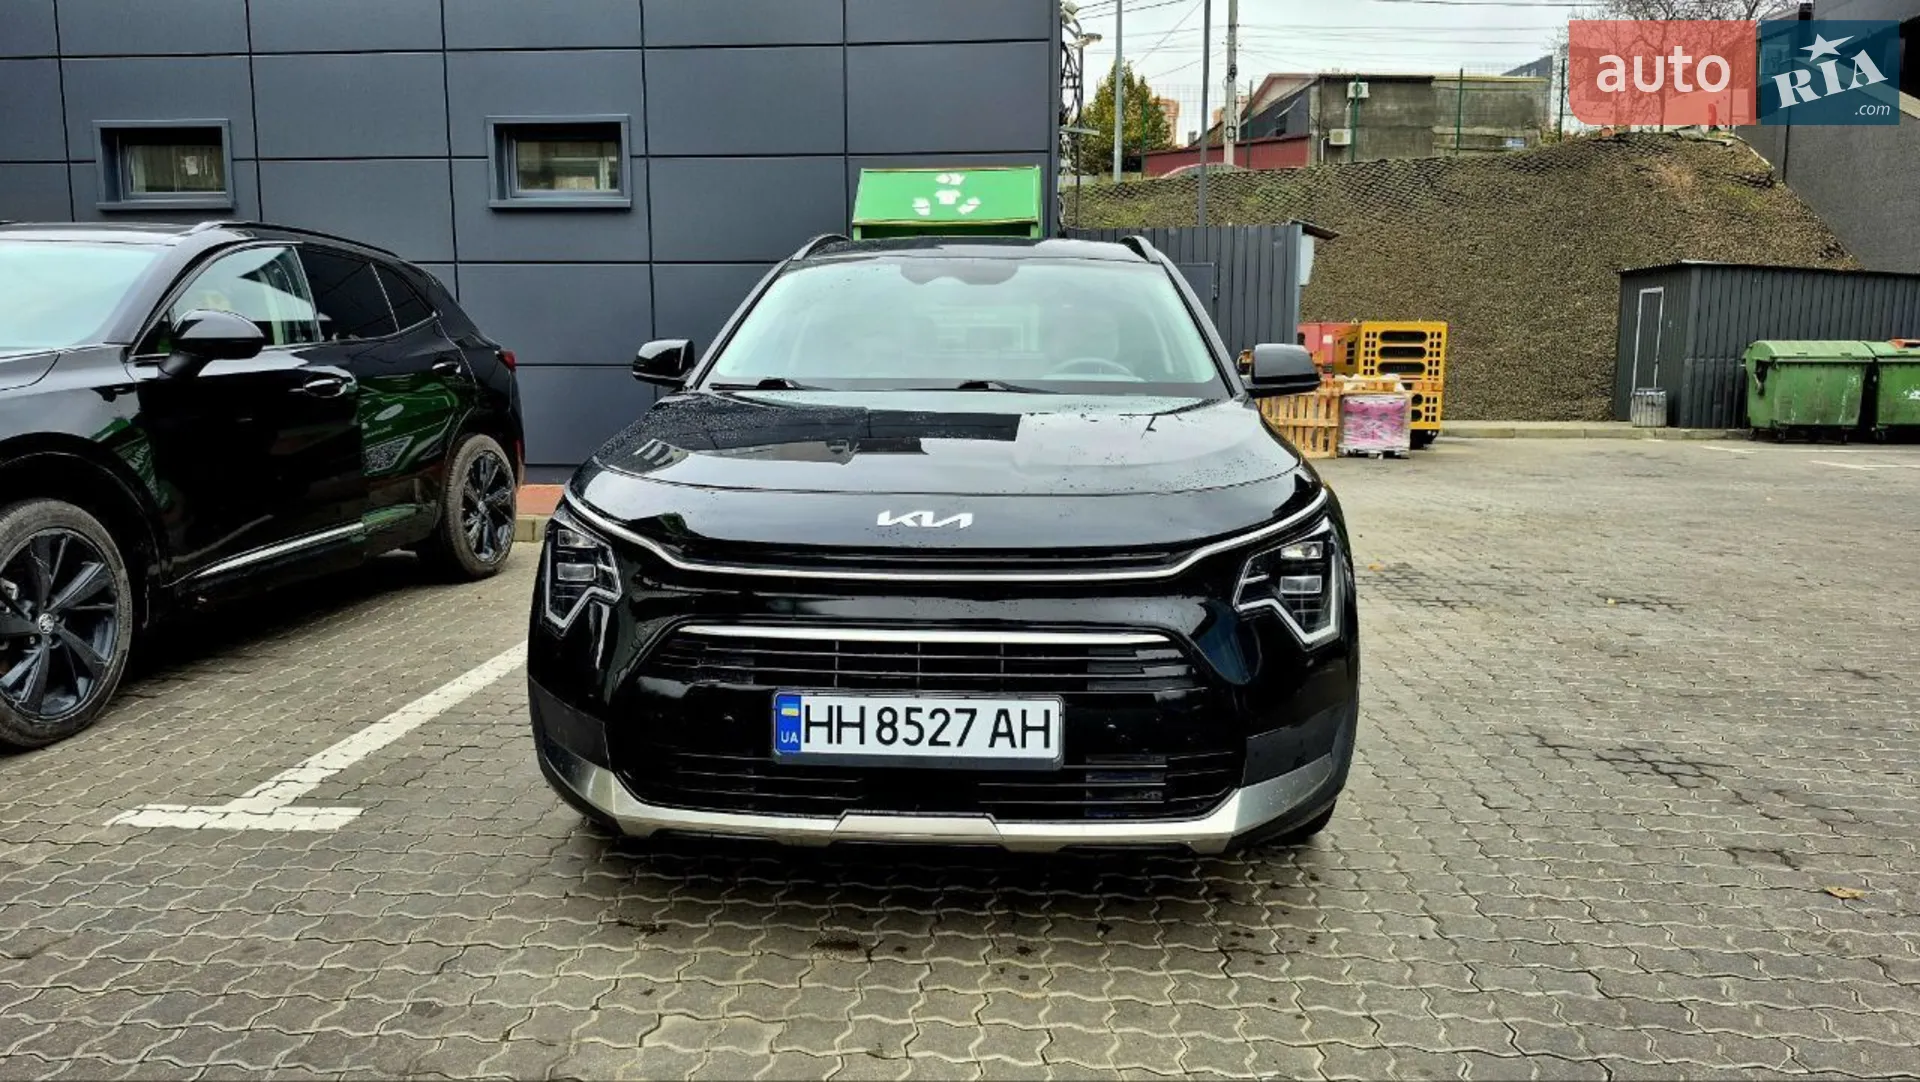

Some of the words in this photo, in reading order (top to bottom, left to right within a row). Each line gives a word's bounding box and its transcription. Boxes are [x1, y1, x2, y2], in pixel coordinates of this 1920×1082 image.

[877, 510, 973, 529] KIA
[804, 704, 865, 745] HH
[876, 706, 977, 747] 8527
[988, 708, 1050, 749] AH
[781, 731, 798, 743] UA
